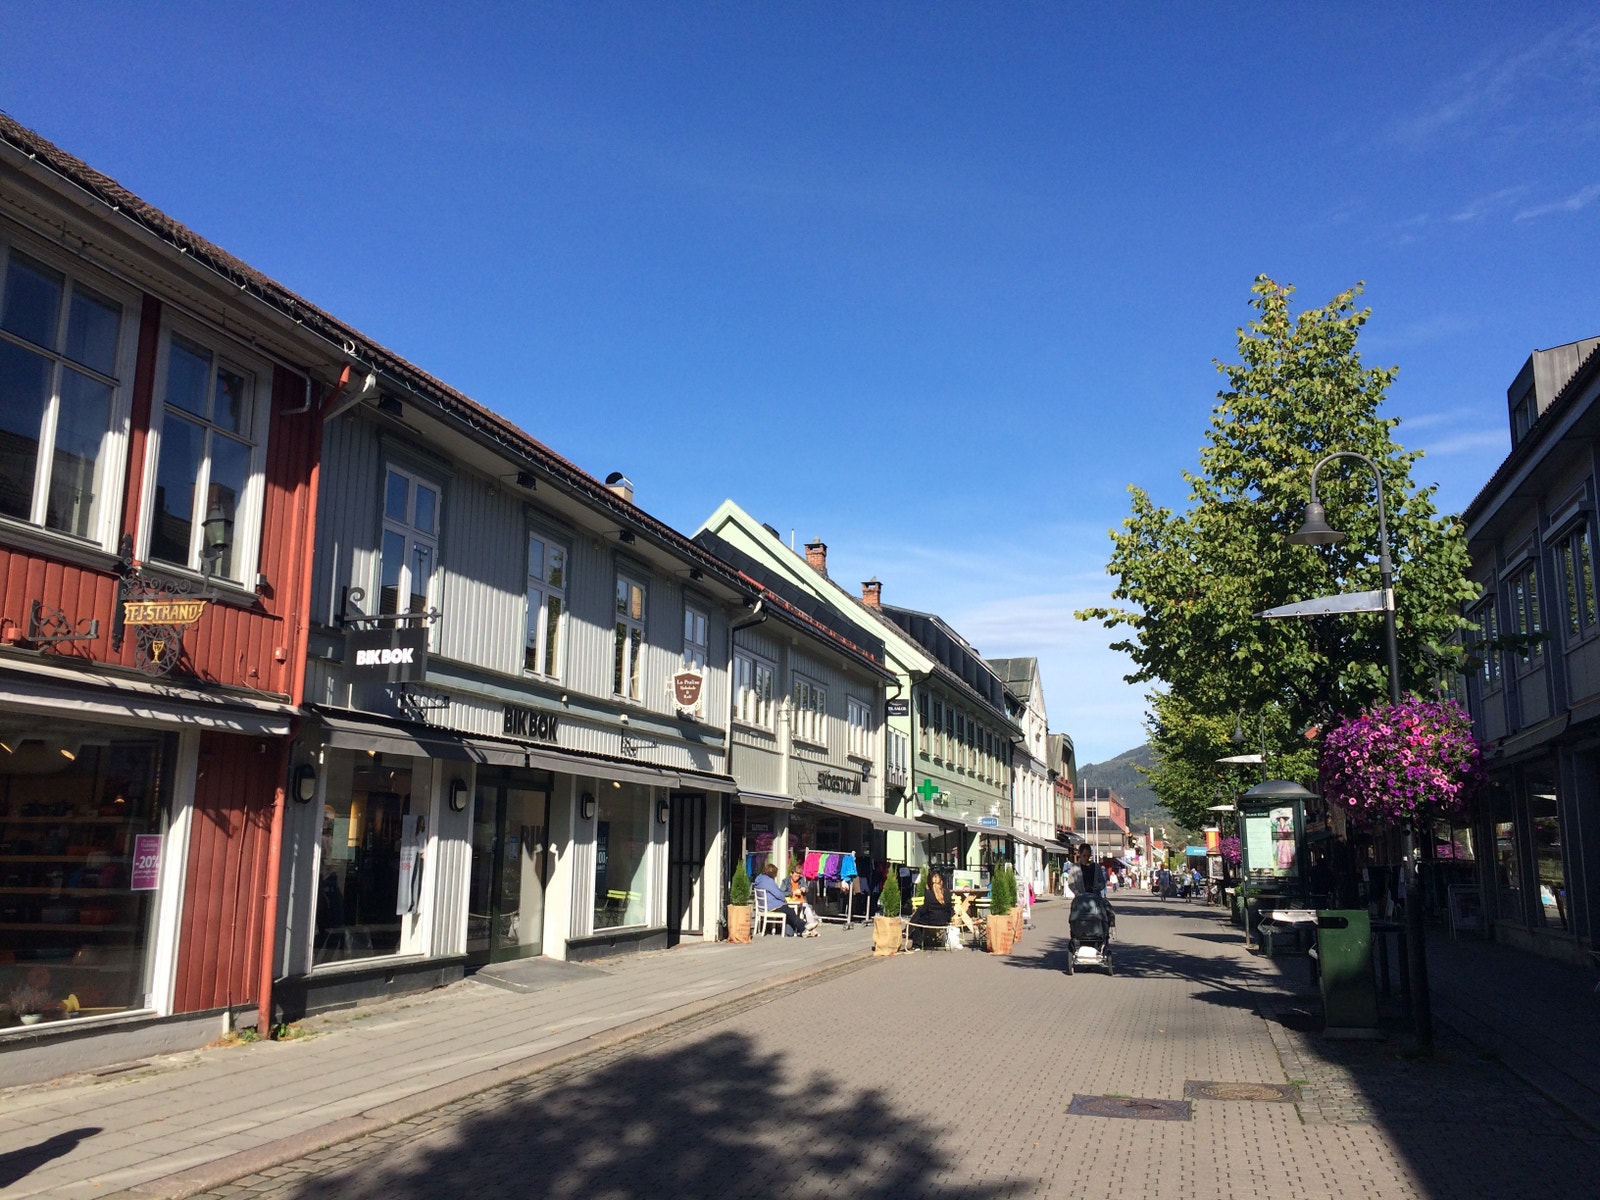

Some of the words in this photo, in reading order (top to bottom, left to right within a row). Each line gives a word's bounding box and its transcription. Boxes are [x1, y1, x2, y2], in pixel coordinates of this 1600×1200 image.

[356, 649, 381, 666] BIK
[381, 647, 414, 664] BOK
[503, 706, 528, 736] BIK
[529, 712, 559, 742] BOK
[135, 855, 160, 869] -20%
